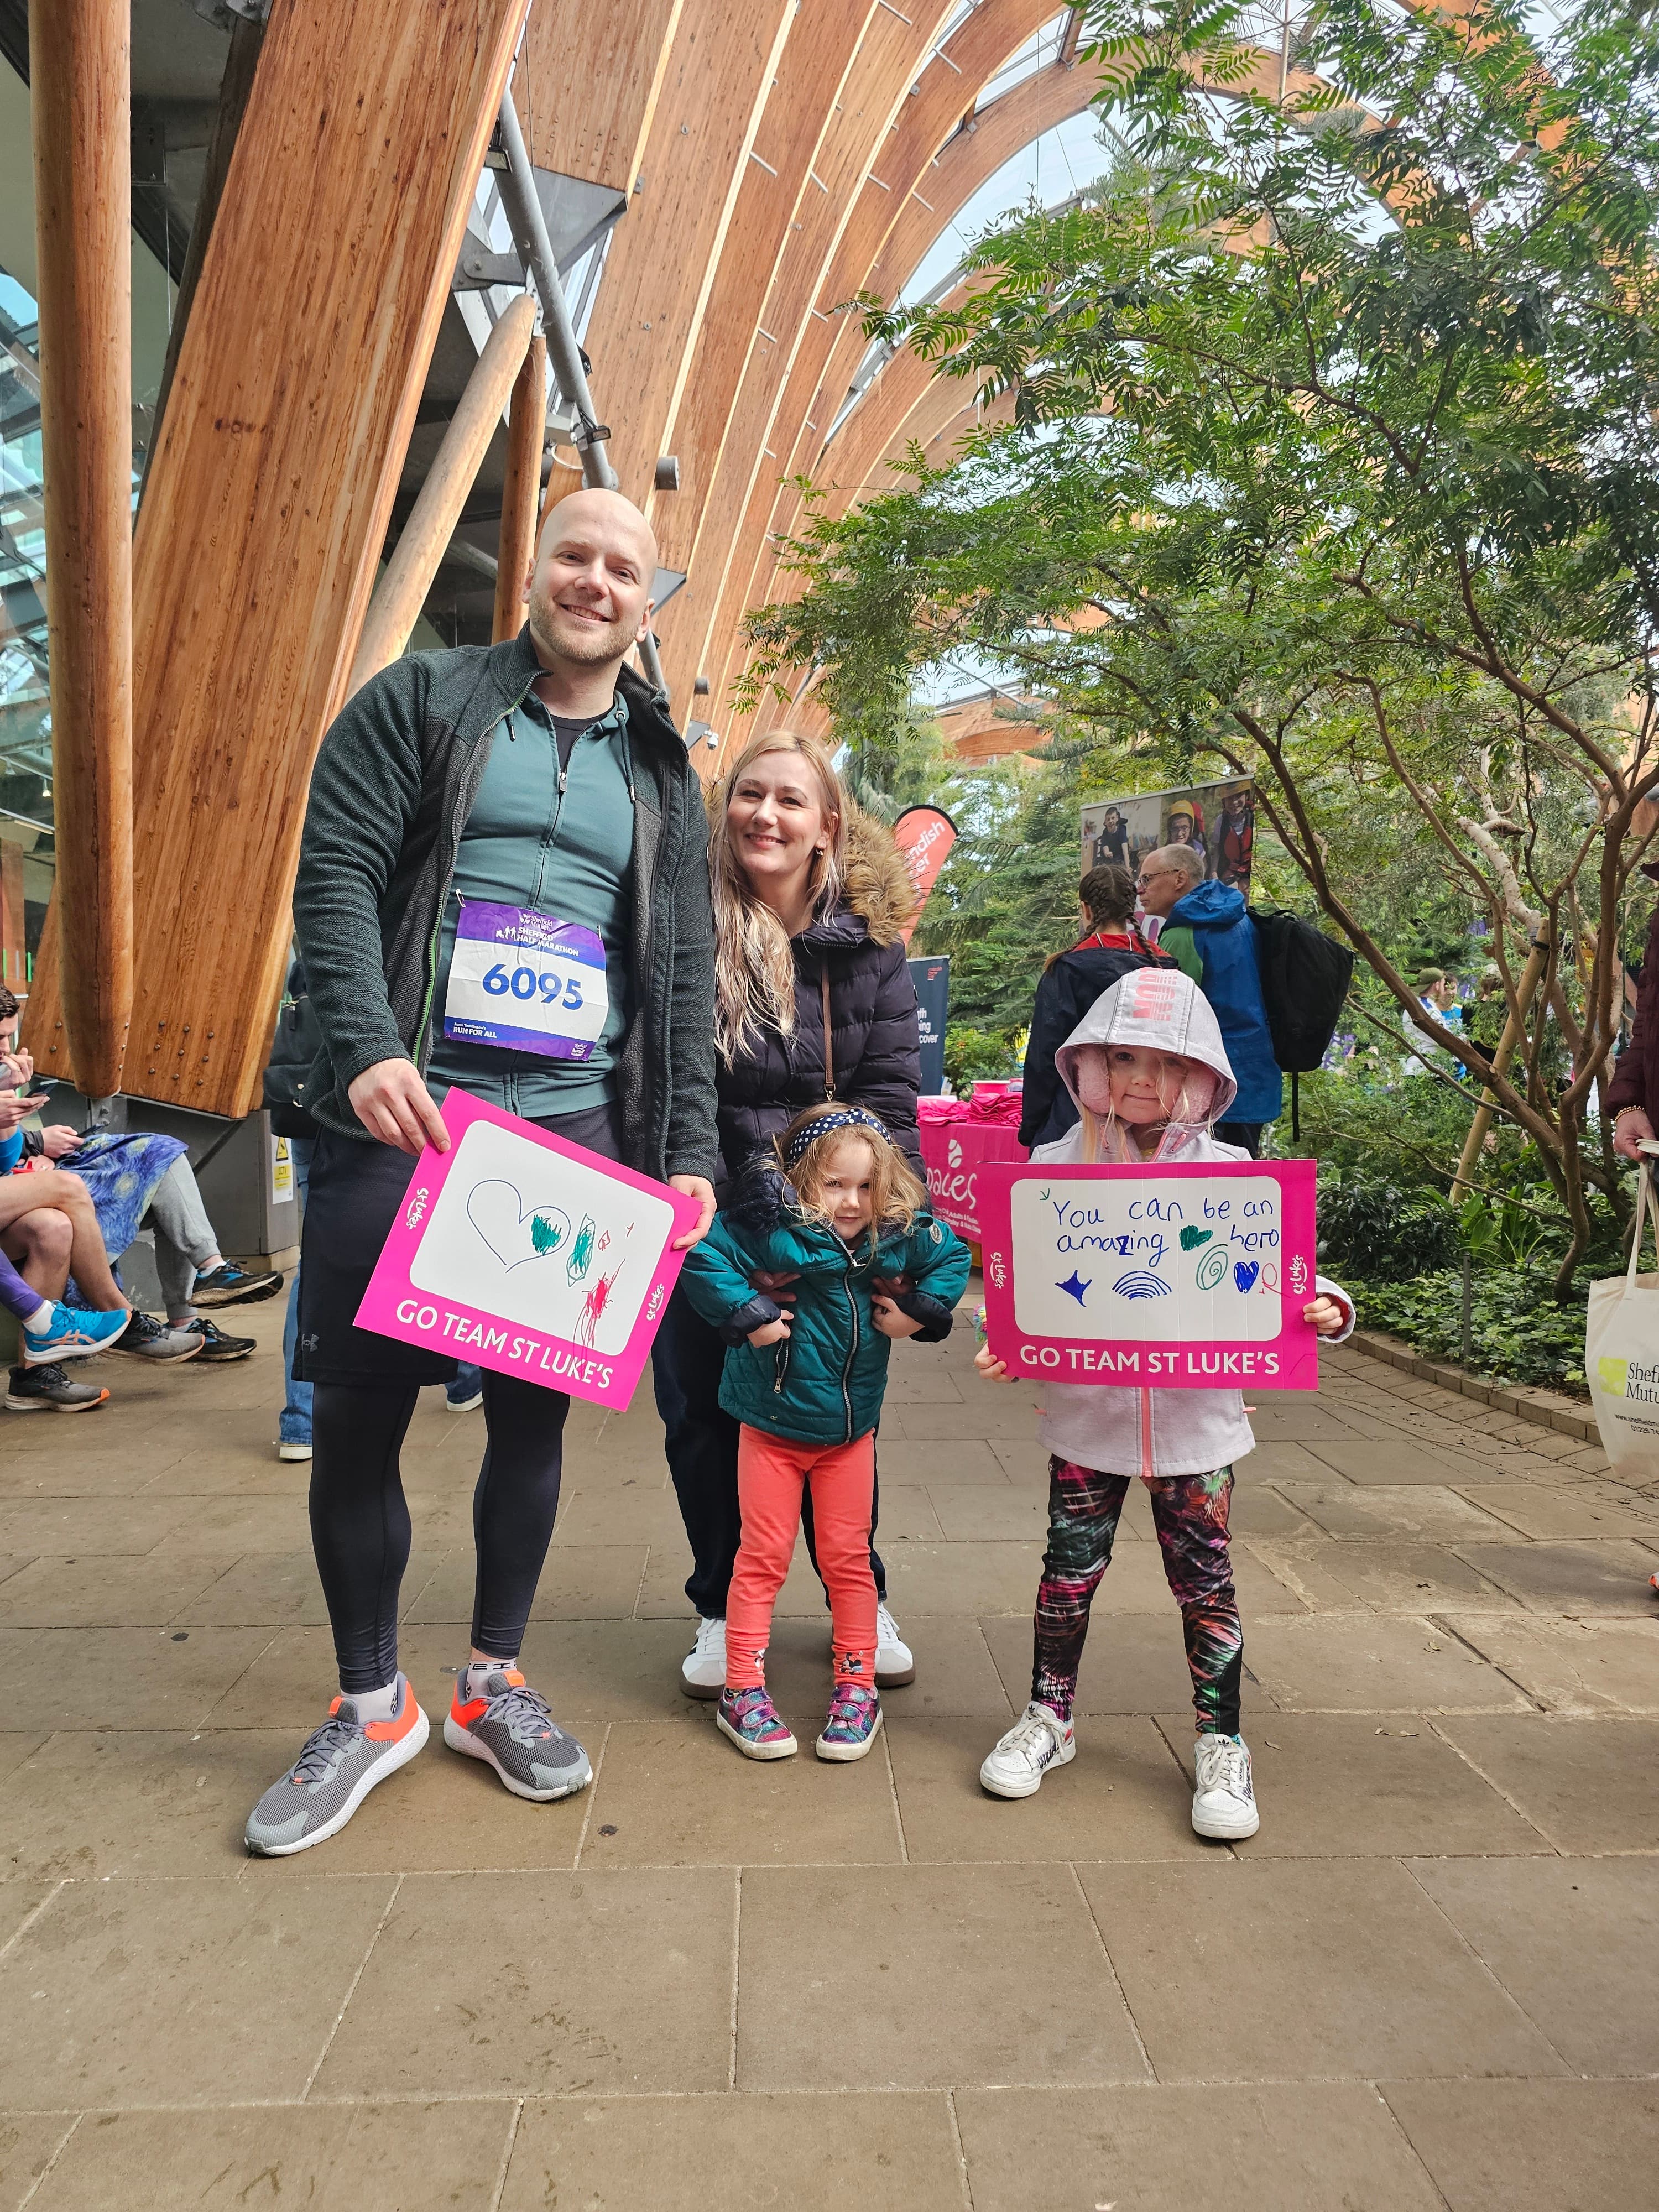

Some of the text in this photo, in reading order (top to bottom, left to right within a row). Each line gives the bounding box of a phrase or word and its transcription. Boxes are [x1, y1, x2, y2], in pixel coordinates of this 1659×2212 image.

[518, 927, 554, 941] SHEFFIELD
[531, 915, 553, 927] Sheffield
[517, 934, 579, 957] HALF MARATHON
[482, 963, 583, 1010] 6095
[1053, 1197, 1274, 1228] You can be an
[1057, 1224, 1280, 1267] amazing hero
[396, 1300, 613, 1389] GO TEAM ST LUKE'S
[1020, 1345, 1279, 1374] GO TEAM ST LUKE'S
